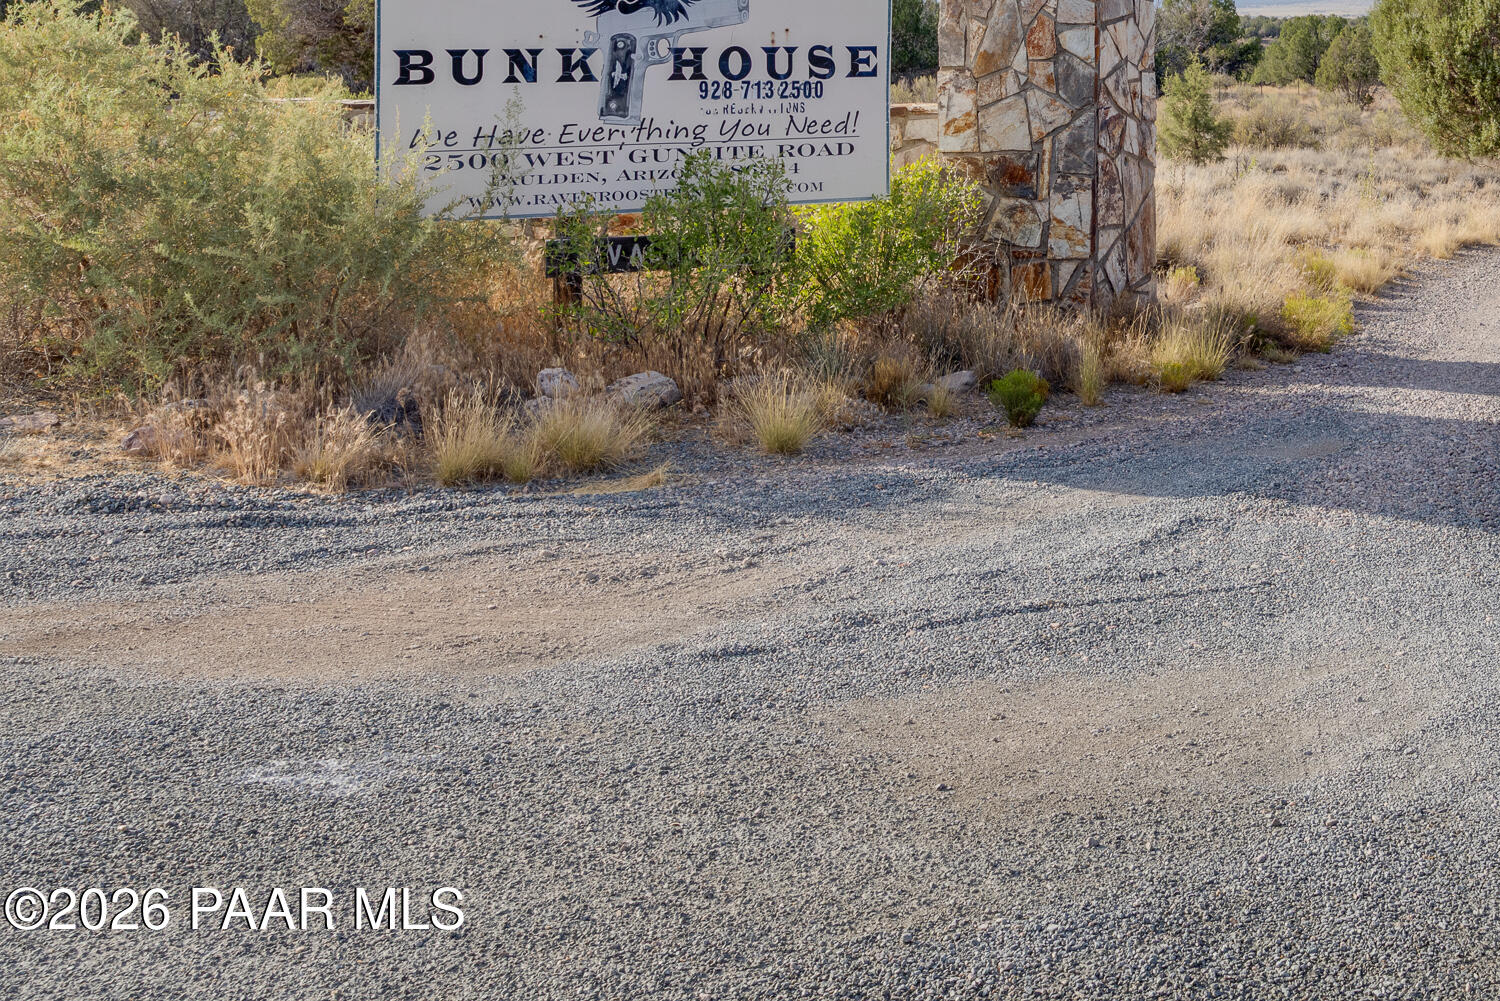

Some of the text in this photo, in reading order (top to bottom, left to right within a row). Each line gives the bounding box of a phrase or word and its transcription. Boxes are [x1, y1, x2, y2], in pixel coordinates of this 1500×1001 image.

[392, 46, 879, 86] BUNK HOUSE
[409, 128, 459, 149] We
[472, 125, 546, 148] Have
[719, 118, 771, 143] You
[784, 110, 860, 136] Need!
[424, 153, 509, 171] 2500
[523, 150, 615, 168] WEST
[776, 142, 855, 160] ROAD
